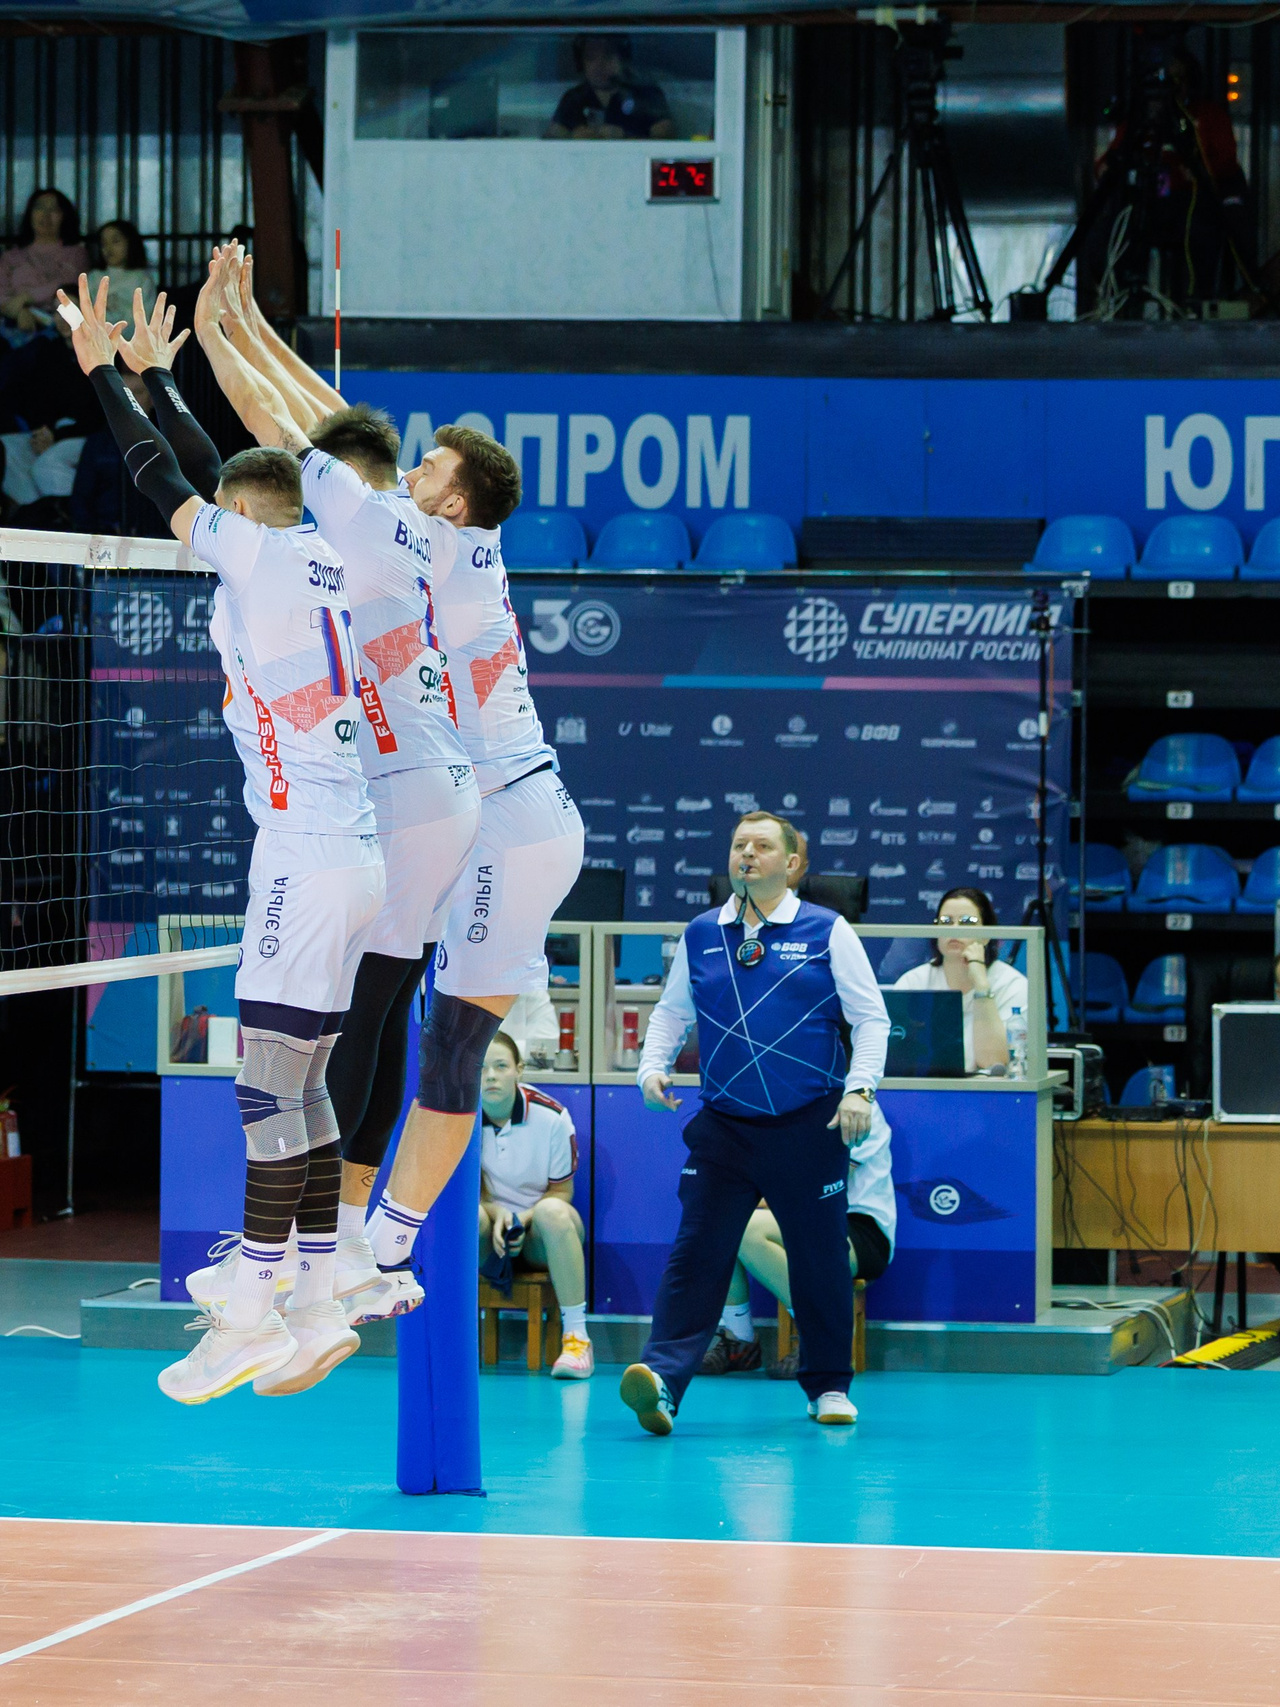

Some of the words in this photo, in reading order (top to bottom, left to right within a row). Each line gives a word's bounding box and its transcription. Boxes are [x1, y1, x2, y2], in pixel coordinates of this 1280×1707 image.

[398, 412, 750, 510] АПРОМ
[1145, 412, 1280, 511] ЮГ
[394, 519, 432, 564] ВЛАСО
[308, 560, 345, 595] ЗУДИ
[853, 639, 969, 660] ЧЕМПИОНАТ
[265, 876, 289, 931] ЭЛЬГА
[474, 865, 493, 919] ЭЛЬГА
